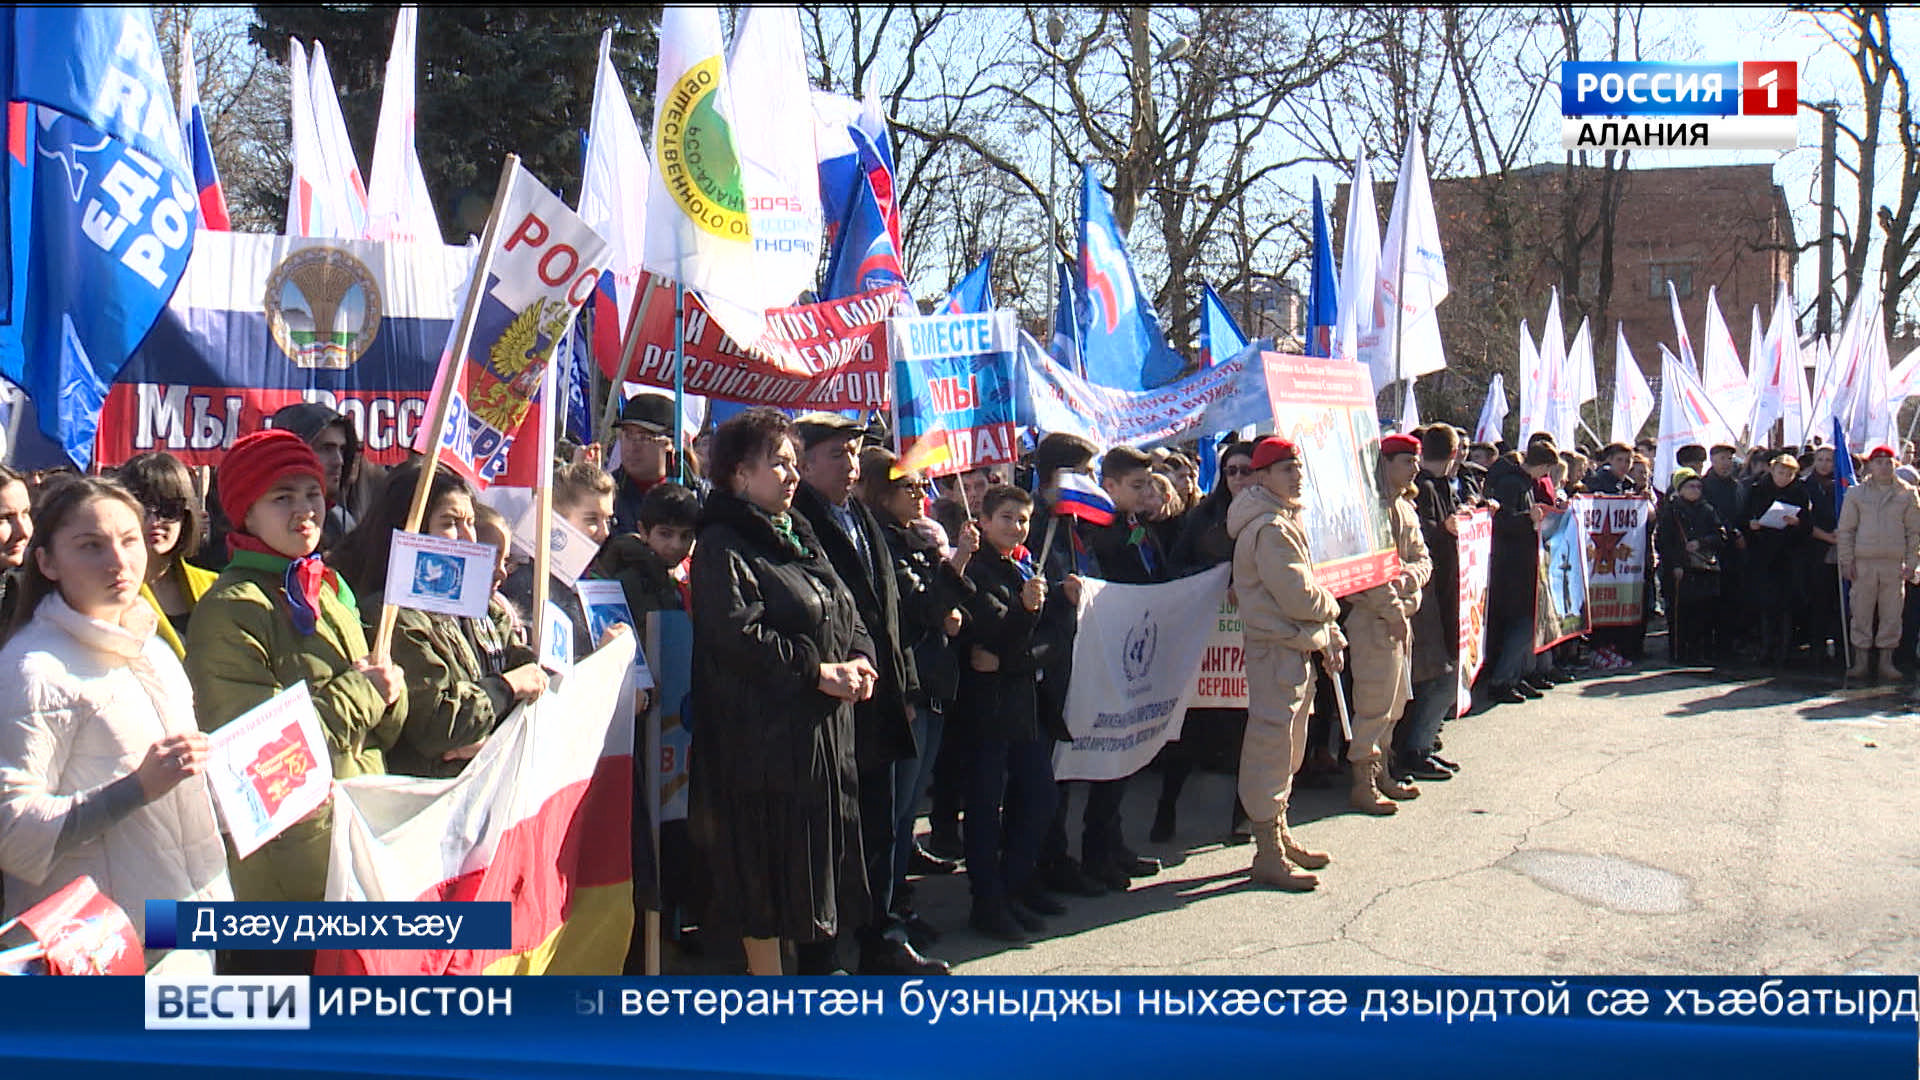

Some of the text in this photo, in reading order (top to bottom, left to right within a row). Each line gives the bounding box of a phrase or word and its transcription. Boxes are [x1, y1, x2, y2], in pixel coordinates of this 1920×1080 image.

[909, 319, 991, 357] ВМЕСТЕ
[807, 370, 891, 407] НАРОД
[929, 375, 980, 414] МЫ
[1198, 677, 1248, 698] СЕРДЦЕ
